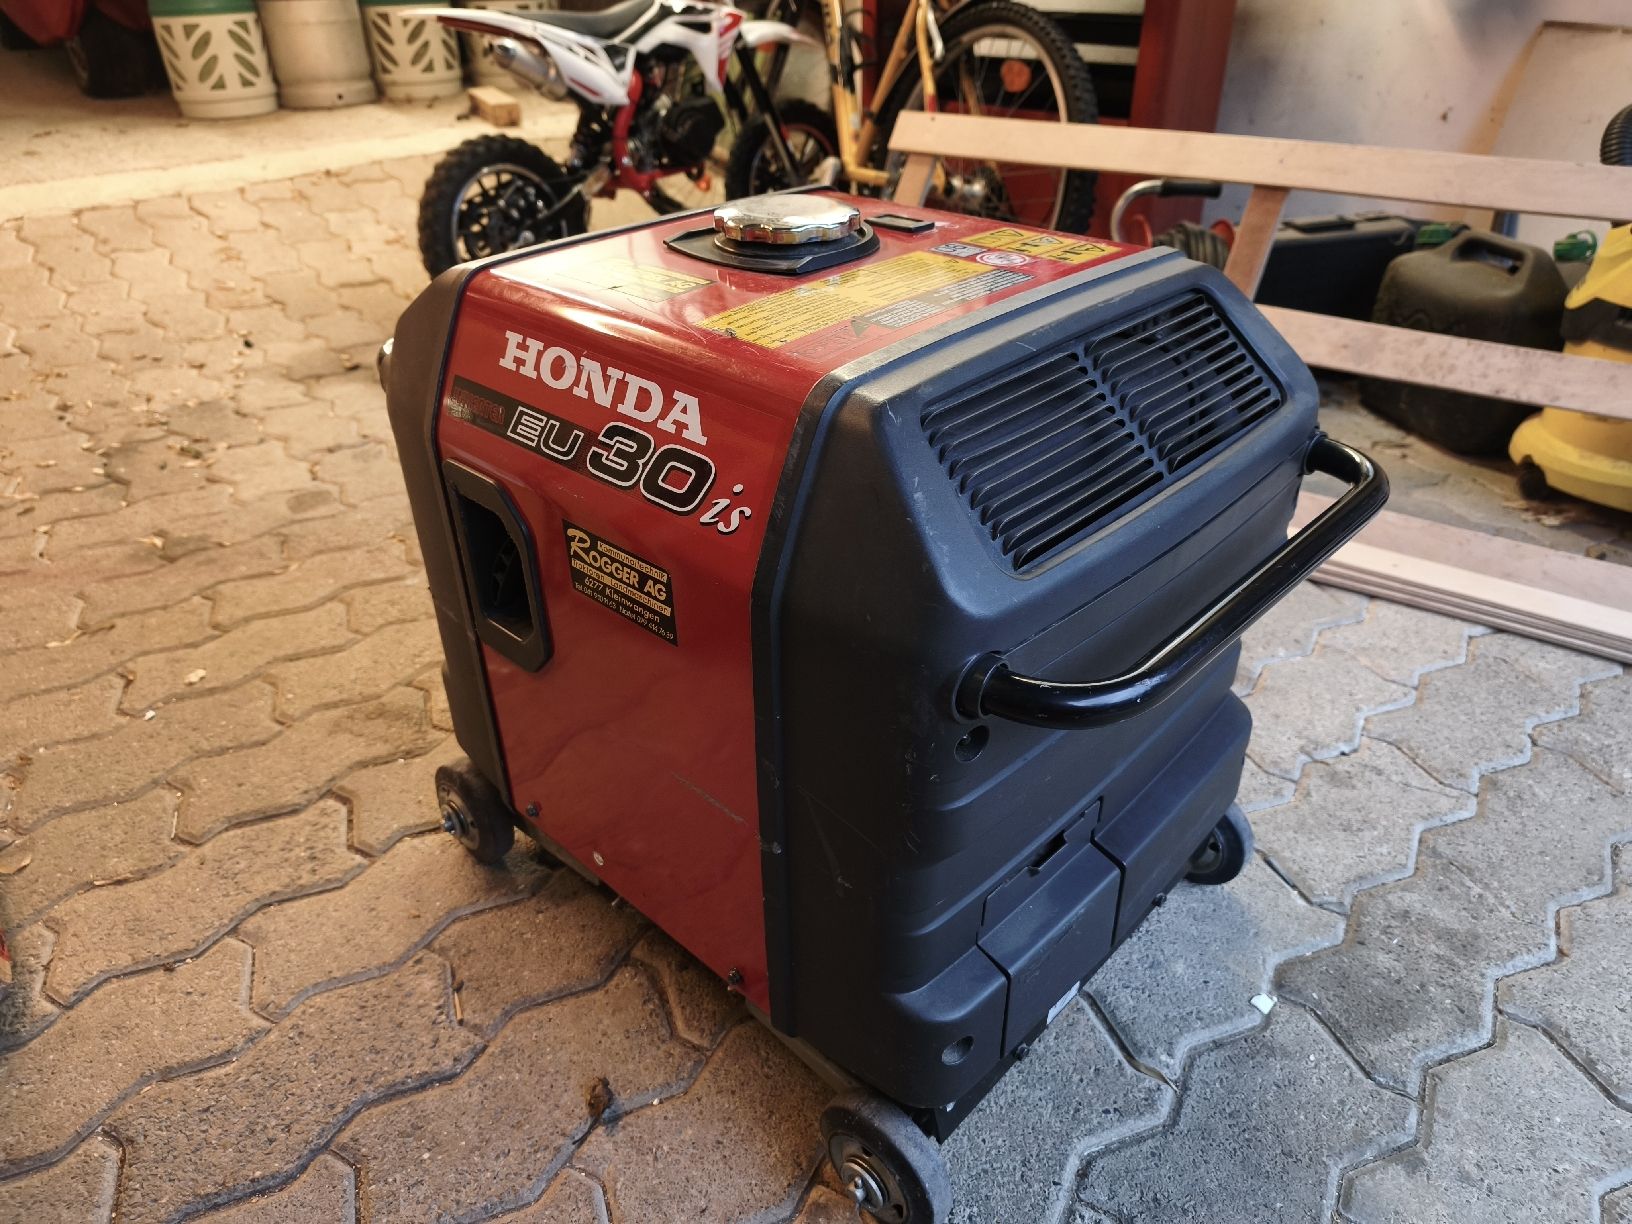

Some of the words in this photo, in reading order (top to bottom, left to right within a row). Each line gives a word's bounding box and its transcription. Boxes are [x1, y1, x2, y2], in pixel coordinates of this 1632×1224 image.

[499, 330, 709, 445] HONDA
[567, 528, 640, 588] ROGGER
[644, 579, 667, 601] AG
[584, 577, 604, 591] 6277
[605, 585, 660, 623] Kleinwangen
